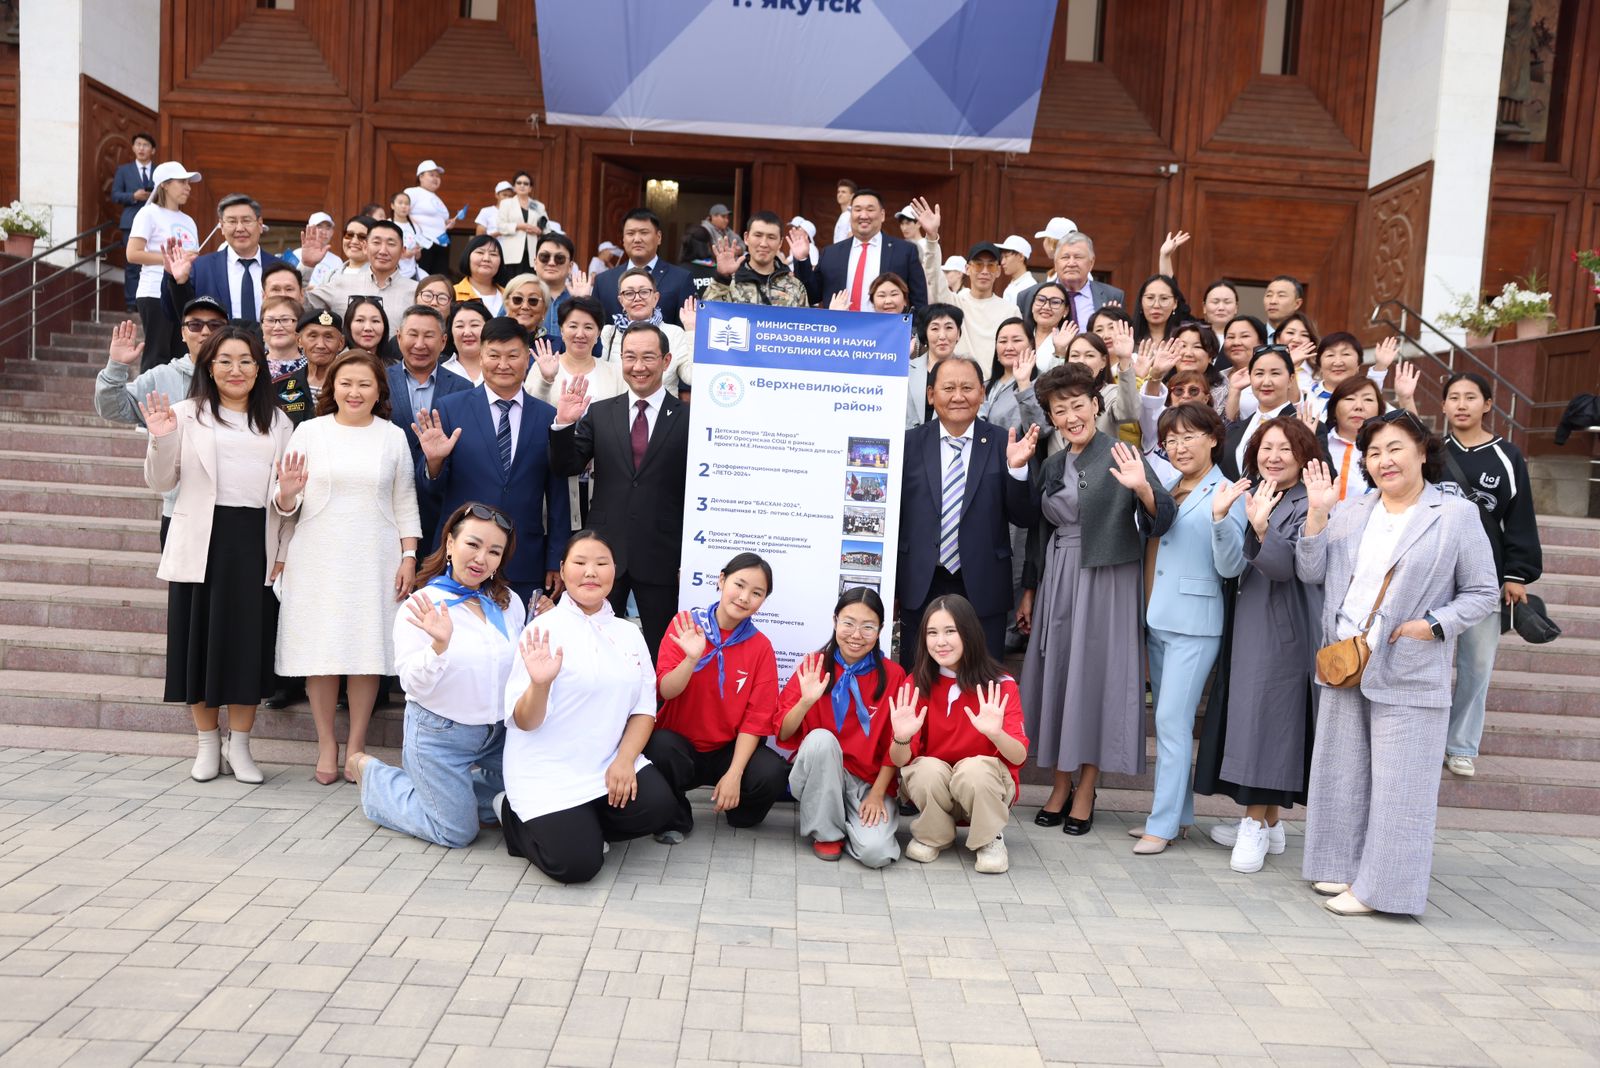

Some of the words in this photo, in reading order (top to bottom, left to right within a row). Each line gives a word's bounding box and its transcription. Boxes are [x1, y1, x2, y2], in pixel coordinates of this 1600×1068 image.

[756, 320, 838, 333] МИНИСТЕРСТВО
[755, 332, 831, 345] ОБРАЗОВАНИЯ
[833, 336, 841, 345] И
[842, 337, 877, 348] НАУКИ
[755, 344, 821, 356] РЕСПУБЛИКИ
[823, 348, 850, 358] САХА
[852, 350, 897, 363] (ЯКУТИЯ)
[750, 377, 884, 396] «Верхневилюйский
[833, 400, 882, 412] район»
[706, 427, 713, 442] 1
[698, 462, 710, 477] 2
[712, 463, 780, 473] Профориентационная
[696, 496, 708, 511] 3
[693, 530, 706, 545] 4
[708, 530, 731, 538] Проект
[773, 535, 808, 543] поддержку
[708, 544, 757, 552] возможностями
[692, 572, 703, 586] 5
